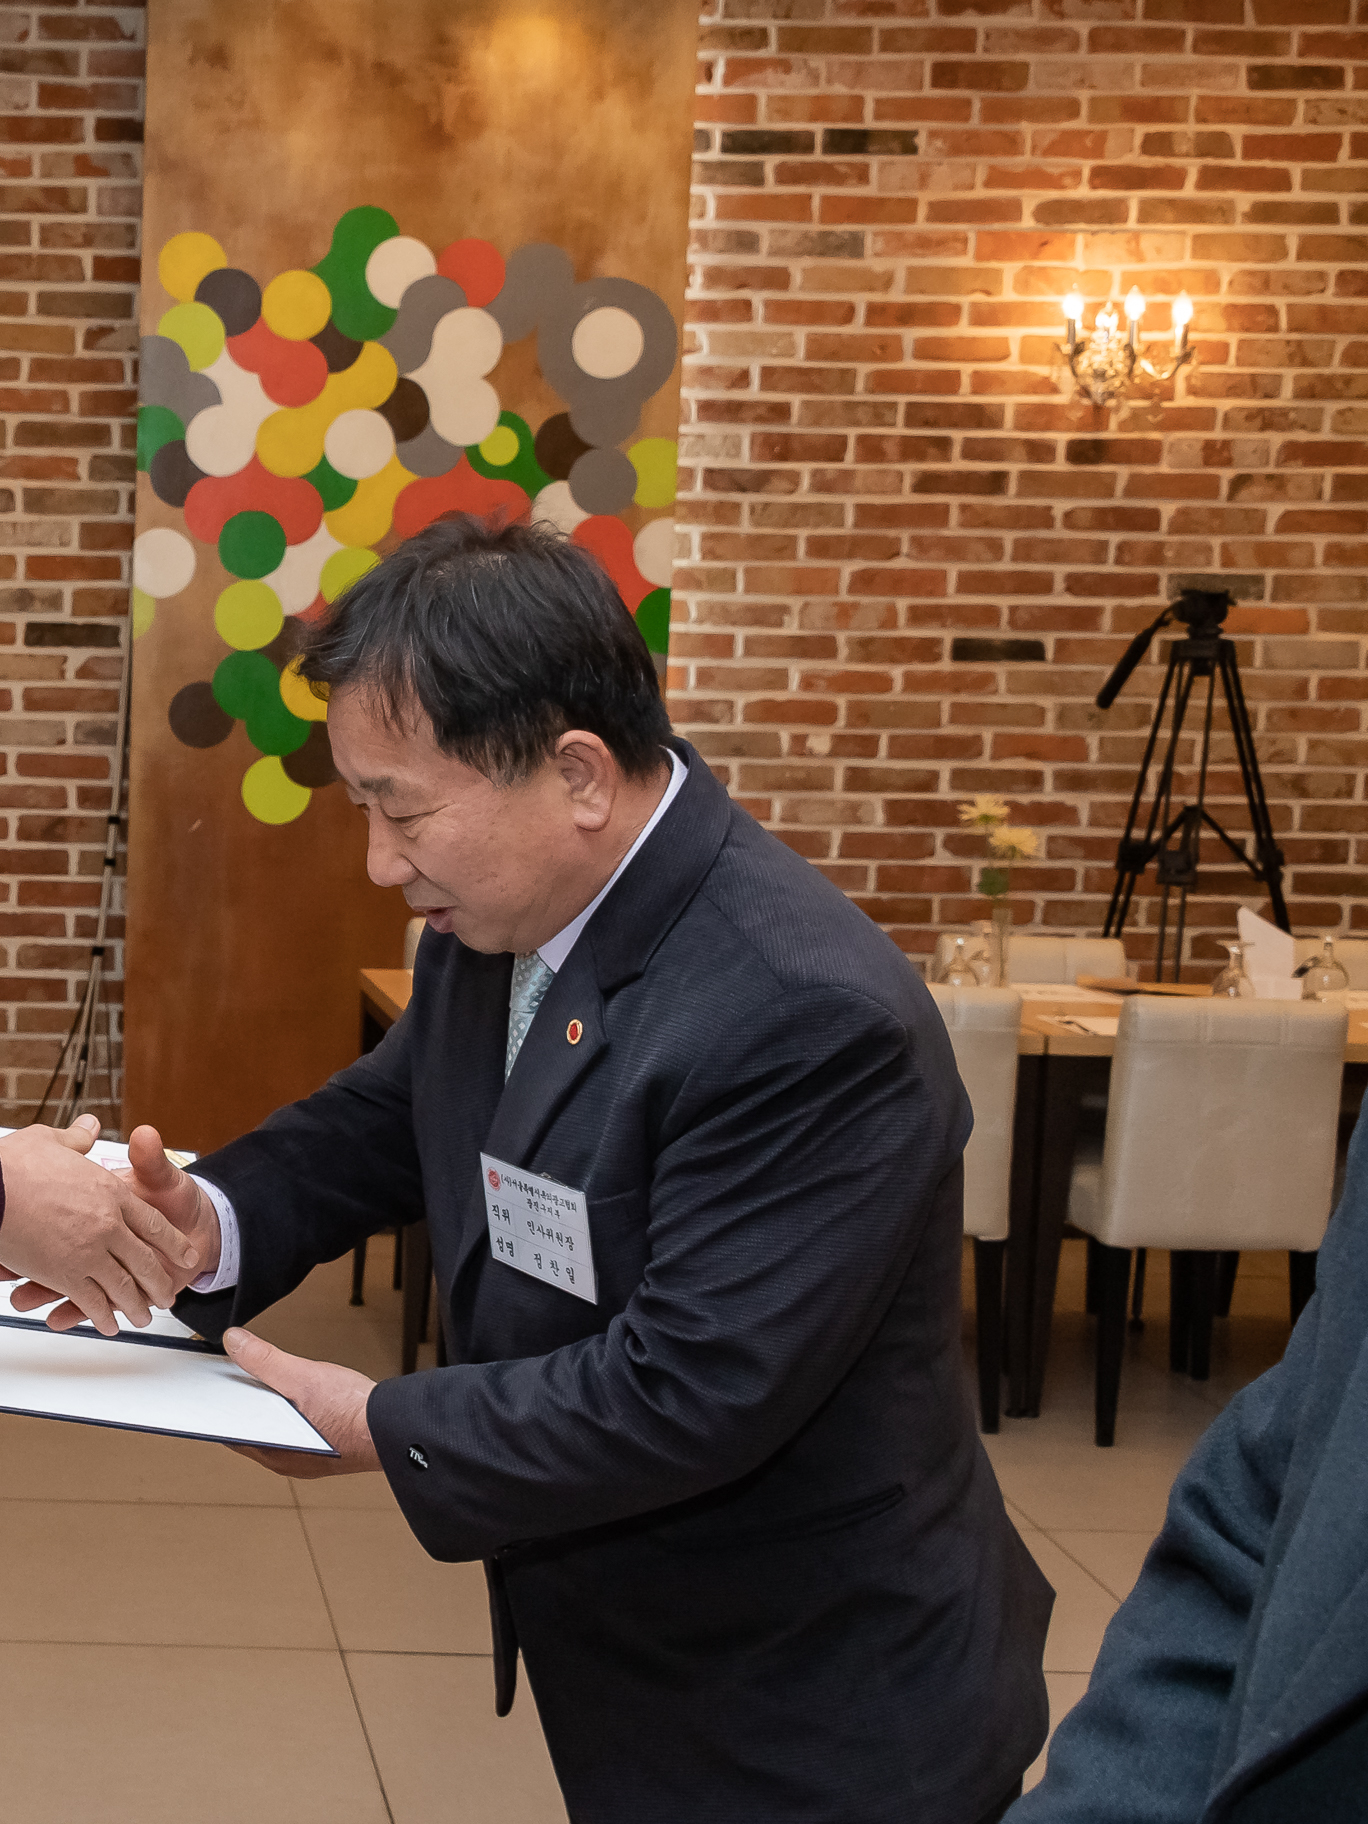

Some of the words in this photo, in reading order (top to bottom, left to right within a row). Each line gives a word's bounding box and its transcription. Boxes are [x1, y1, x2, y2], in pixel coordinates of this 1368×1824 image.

[491, 1204, 511, 1226] 직위
[496, 1236, 514, 1258] 성명
[526, 1220, 574, 1252] 인사위원장
